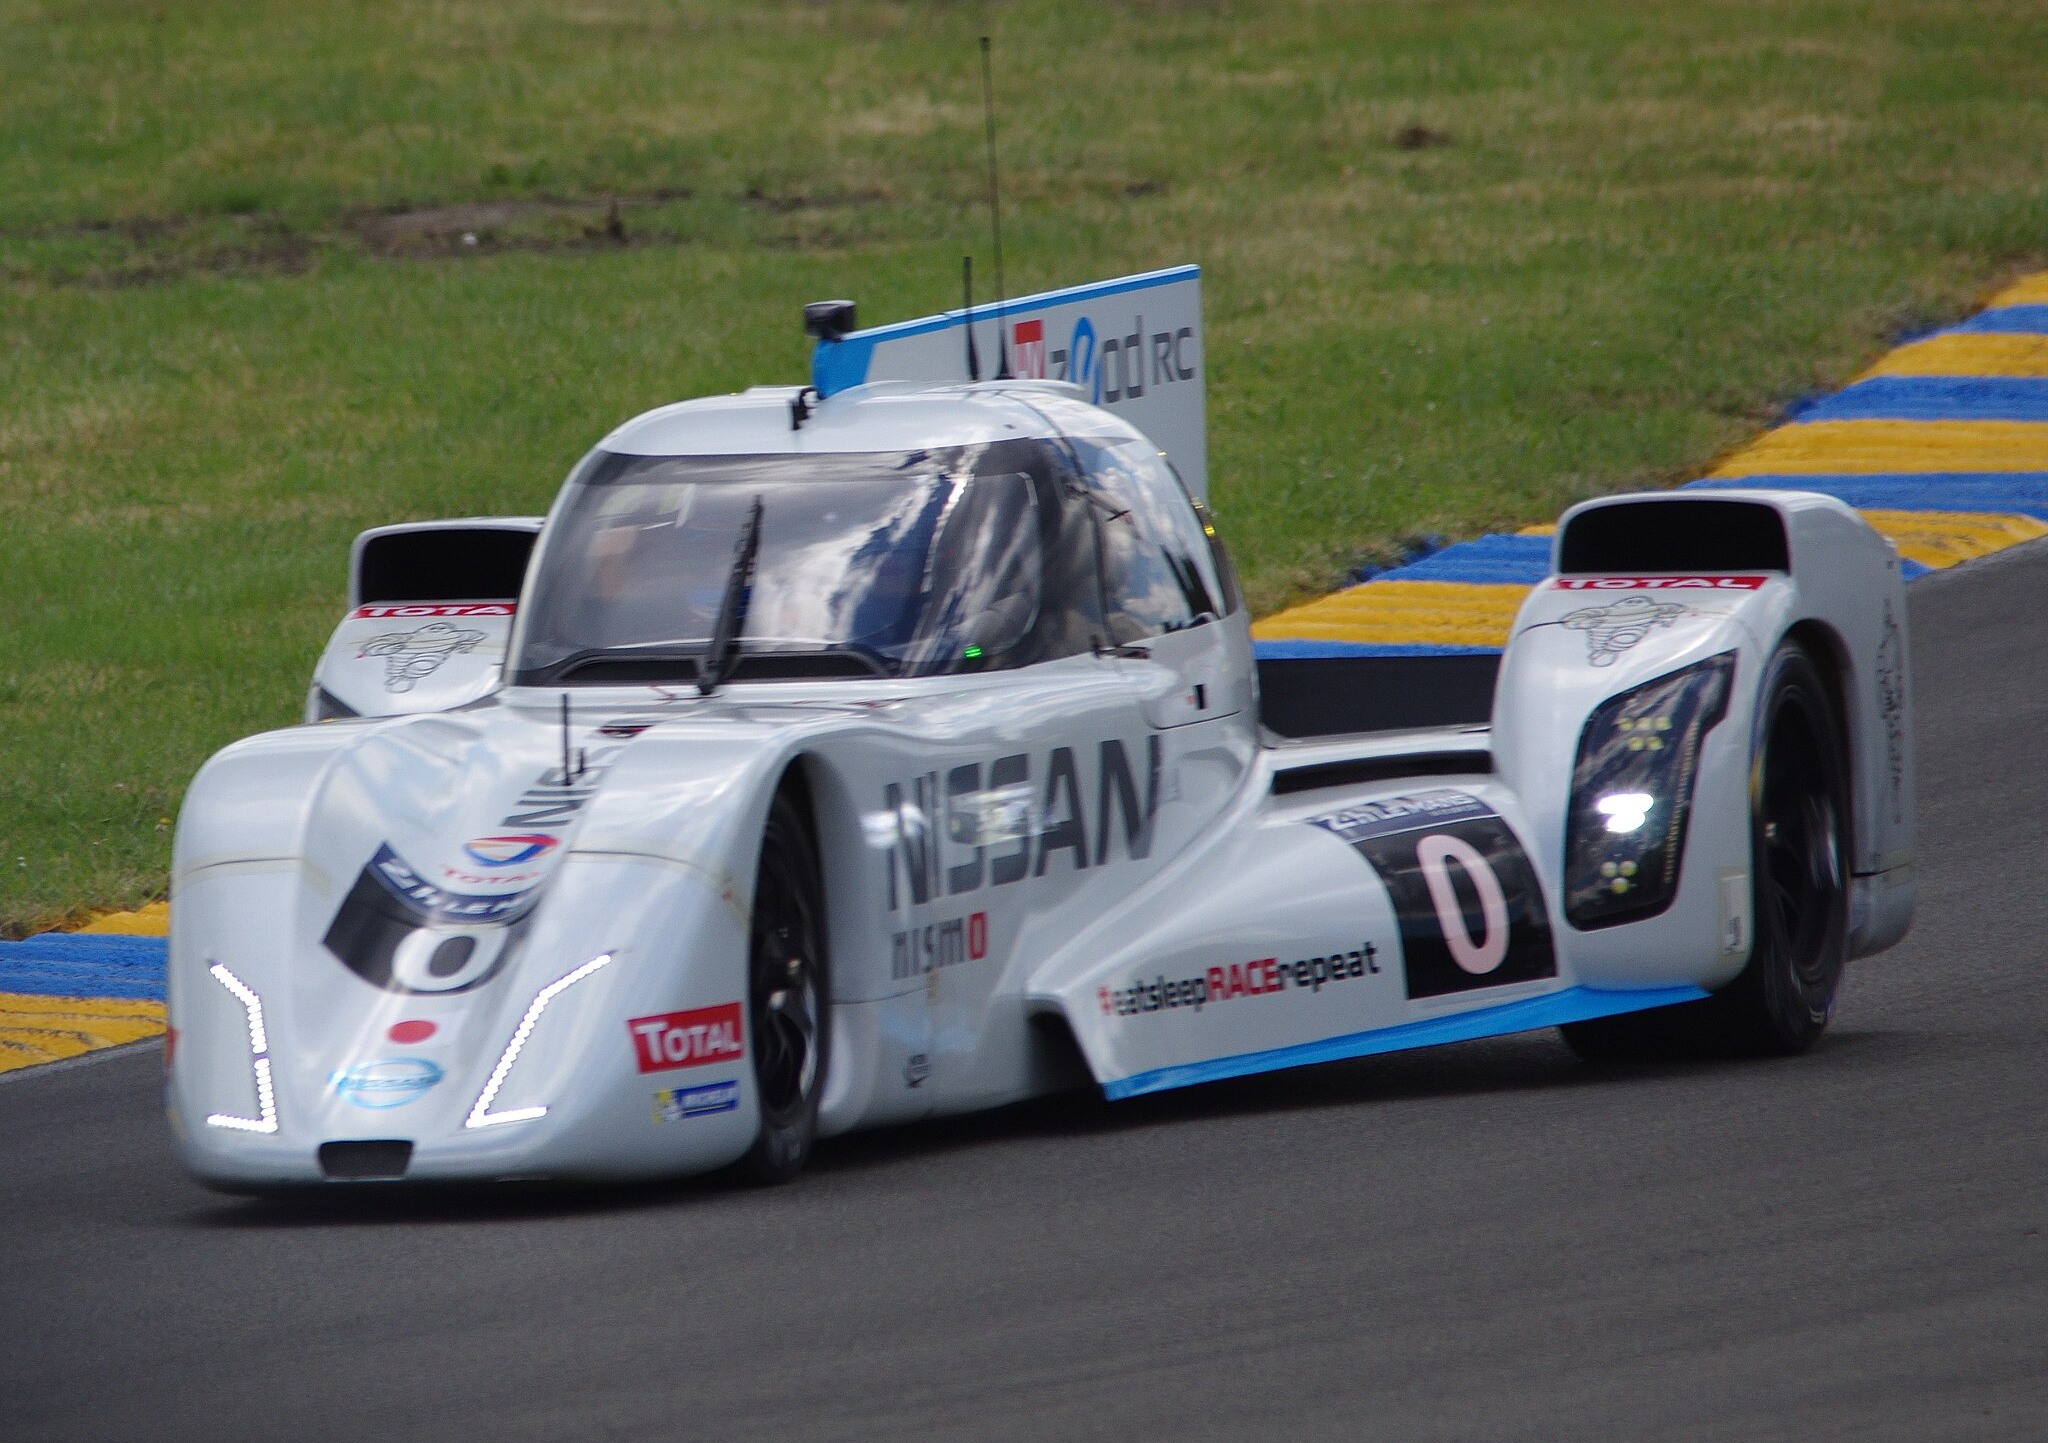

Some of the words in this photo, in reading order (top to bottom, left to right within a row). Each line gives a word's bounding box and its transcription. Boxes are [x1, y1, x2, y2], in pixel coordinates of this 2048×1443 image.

[1153, 326, 1196, 386] RC
[366, 606, 511, 617] TOTA
[1560, 578, 1756, 590] TOTAL
[884, 734, 1161, 912] NISSAN
[1416, 834, 1511, 975] 0
[391, 925, 510, 993] 0
[633, 1020, 740, 1065] TOTAL
